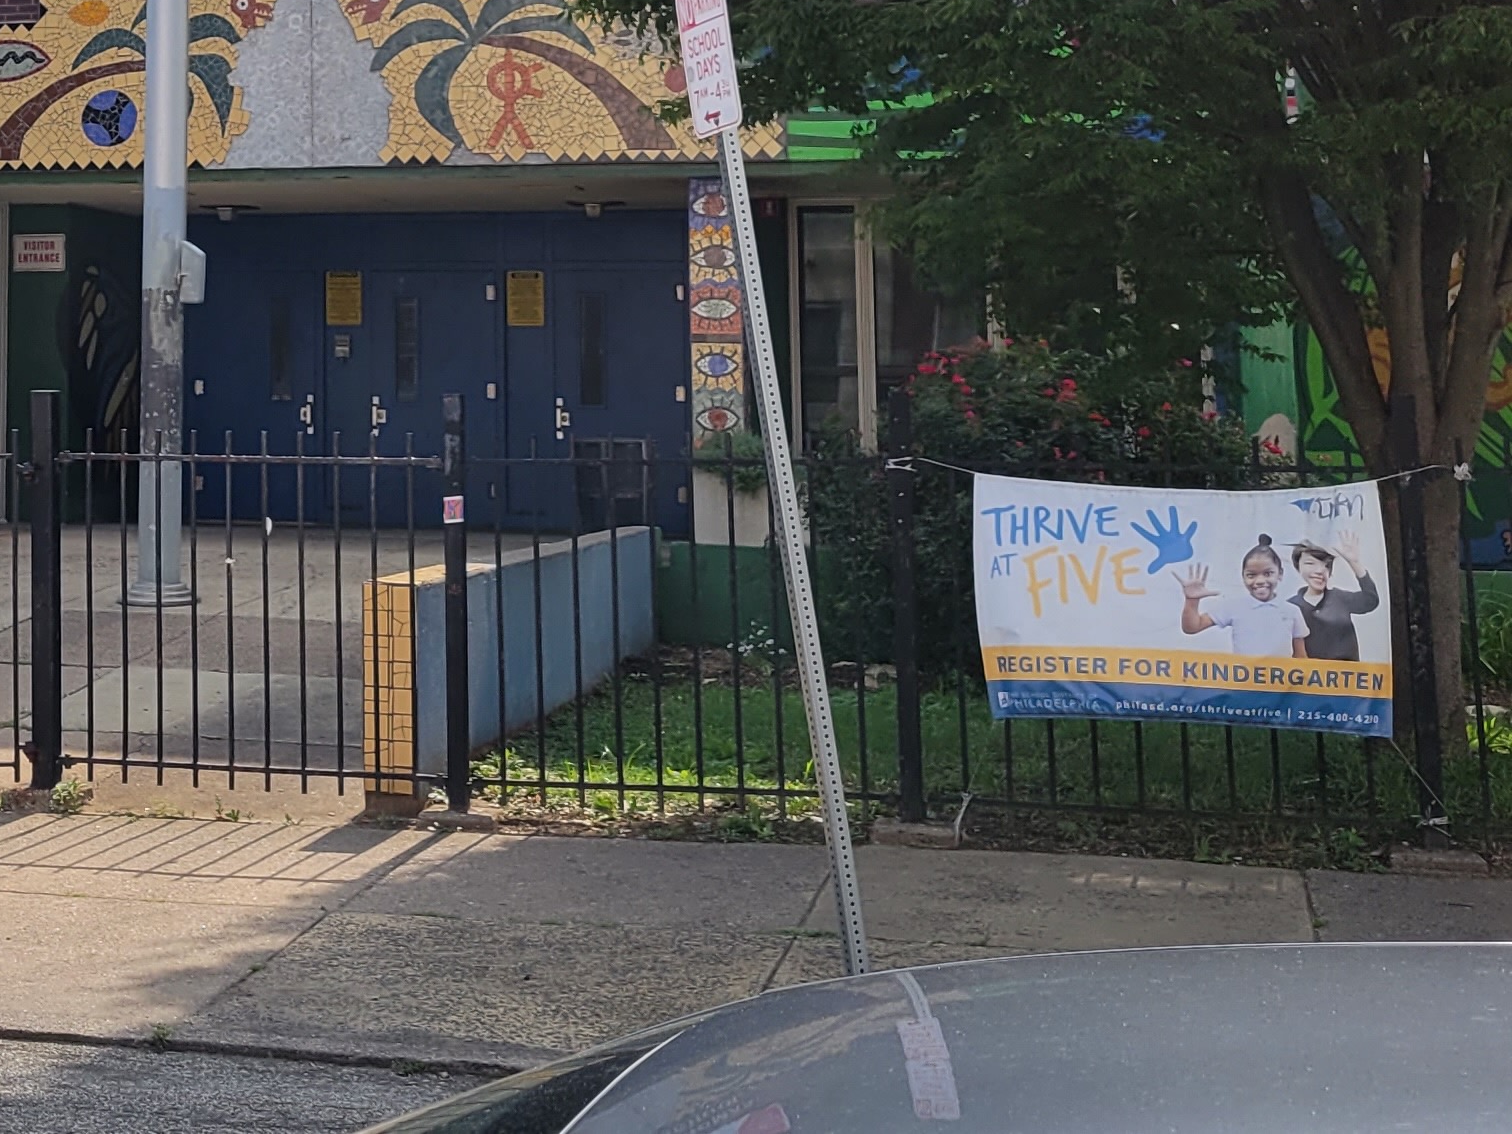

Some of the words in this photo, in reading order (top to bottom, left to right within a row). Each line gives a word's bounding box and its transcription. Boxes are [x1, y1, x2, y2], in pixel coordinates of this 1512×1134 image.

[688, 27, 725, 58] SCHOOL
[696, 54, 721, 80] DAYS
[18, 253, 60, 263] ENTRANCE
[24, 241, 55, 251] VISITOR
[981, 503, 1120, 546] THRIVE
[990, 553, 1019, 579] AT
[1022, 545, 1146, 618] FIVE
[997, 655, 1108, 675] REGISTER
[1118, 657, 1172, 678] FOR
[1183, 661, 1384, 691] KINDERGARTEN
